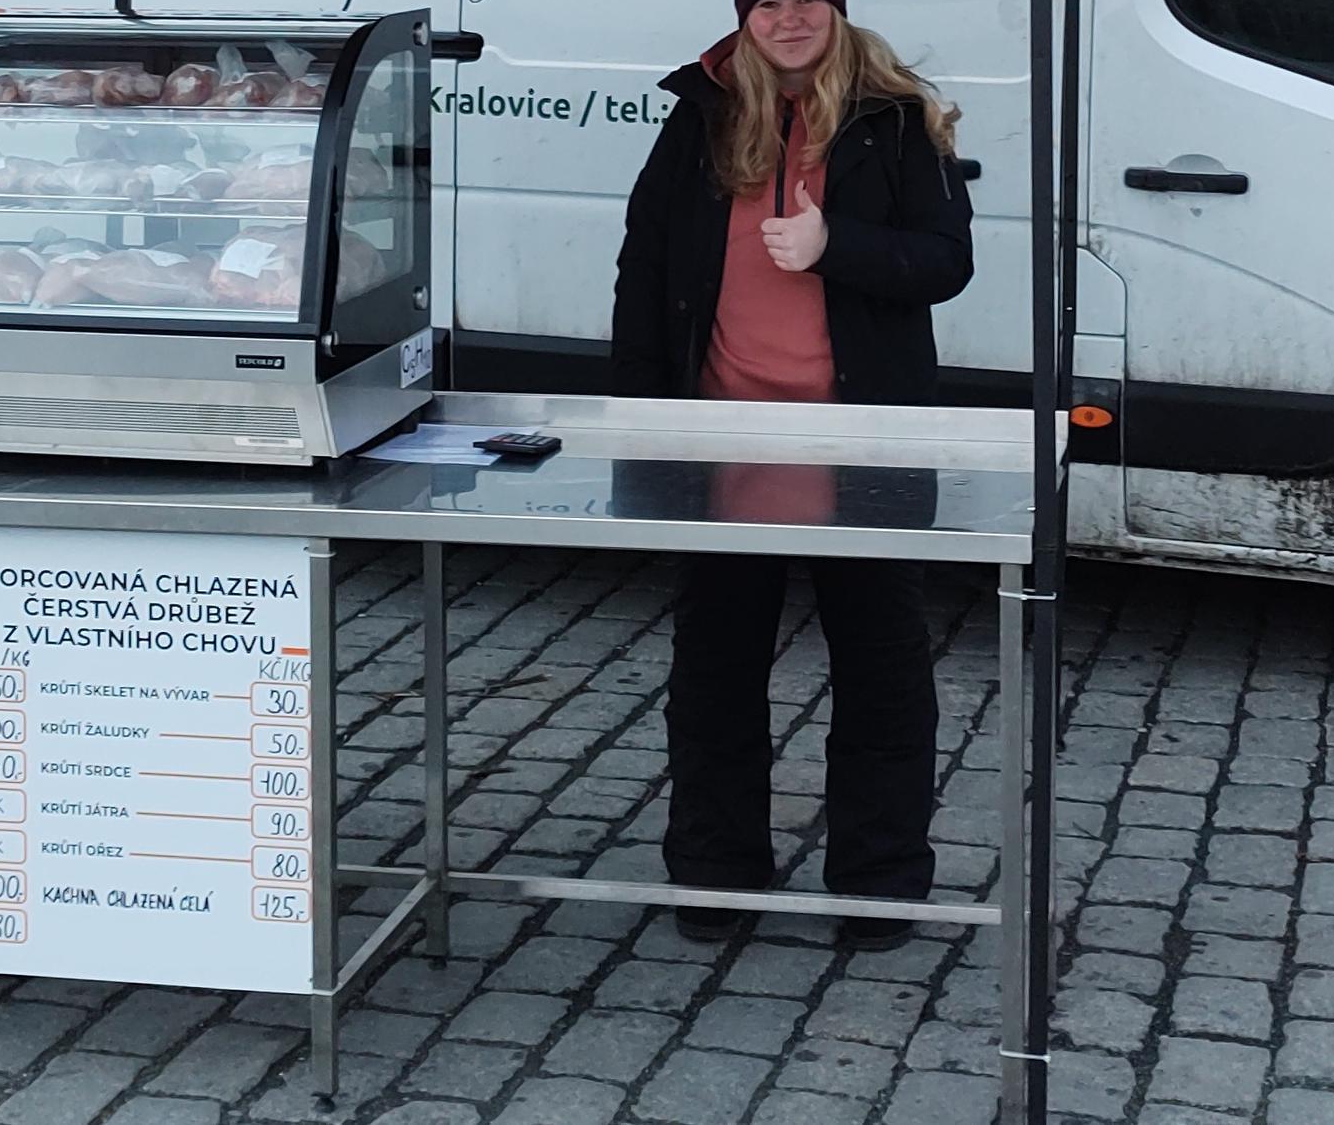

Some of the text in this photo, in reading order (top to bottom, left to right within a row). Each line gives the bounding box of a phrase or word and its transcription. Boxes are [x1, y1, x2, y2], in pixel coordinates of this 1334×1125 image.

[579, 90, 597, 127] /
[156, 573, 298, 599] CHLAZENÁ
[24, 593, 256, 625] ČERSTVÁ DRŮBEŽ
[3, 625, 276, 655] Z VLASTNÍHO CHOVU
[84, 685, 135, 698] SKELET
[139, 688, 160, 699] NA
[163, 686, 210, 702] VÝVAR
[85, 722, 150, 739] ŽALUDKY
[85, 765, 132, 778] SRDCE
[85, 803, 130, 818] JÁTRA
[43, 887, 100, 906] KACHNA
